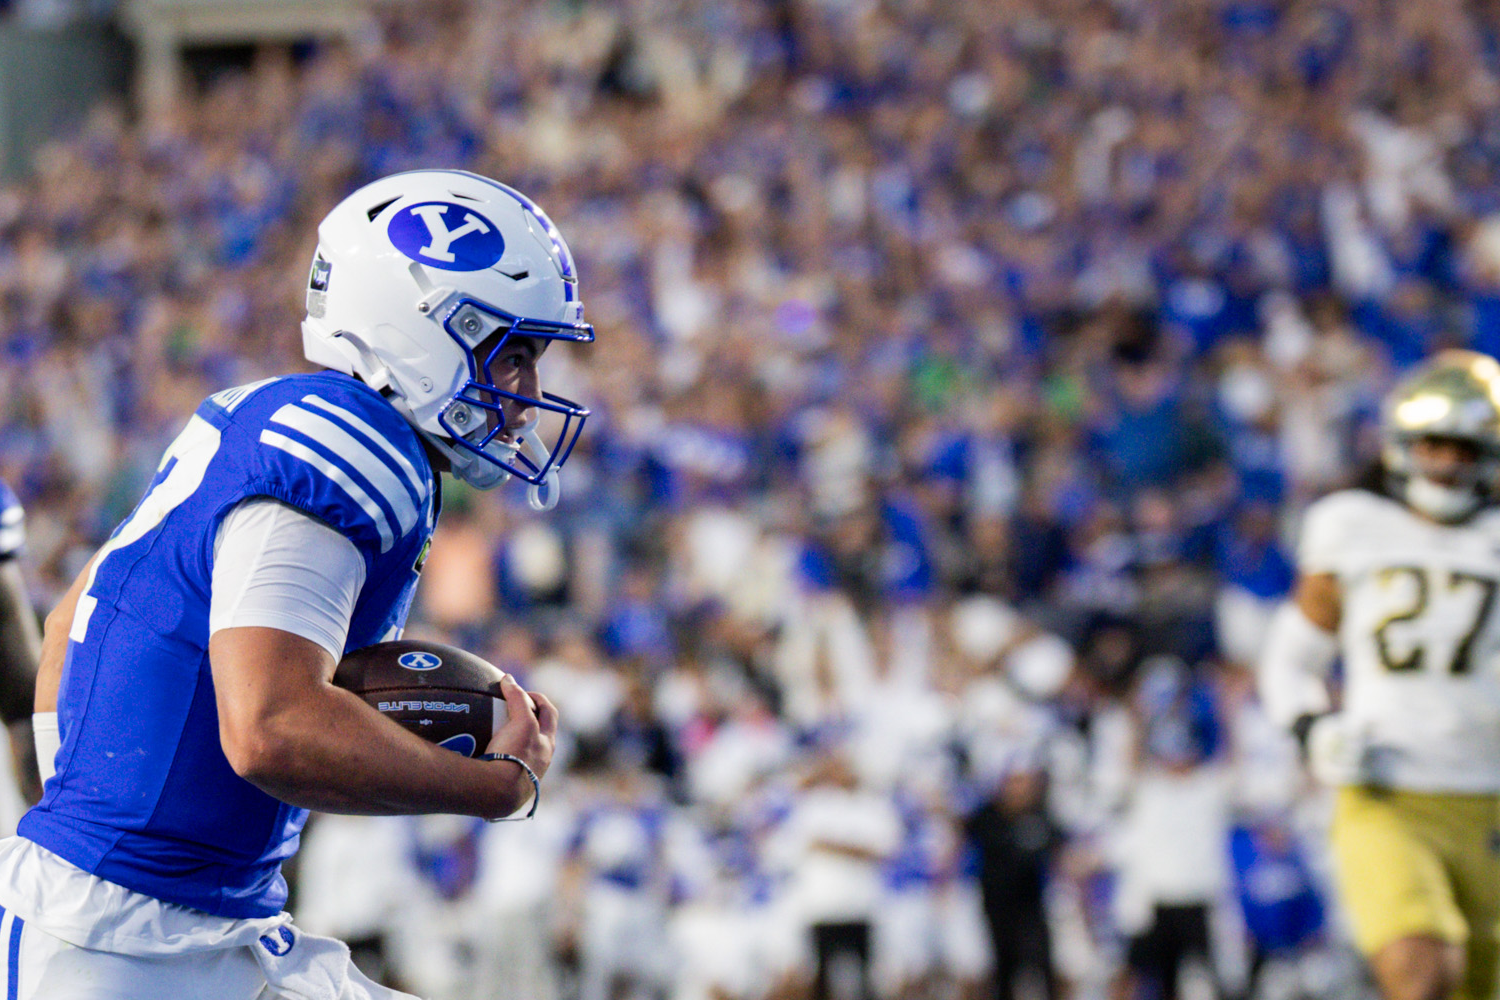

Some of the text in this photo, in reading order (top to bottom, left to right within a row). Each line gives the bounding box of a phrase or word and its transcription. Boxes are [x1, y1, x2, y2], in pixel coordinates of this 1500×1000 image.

[410, 205, 490, 262] Y
[1374, 565, 1500, 675] 27
[378, 701, 470, 714] VAPOR ELITE
